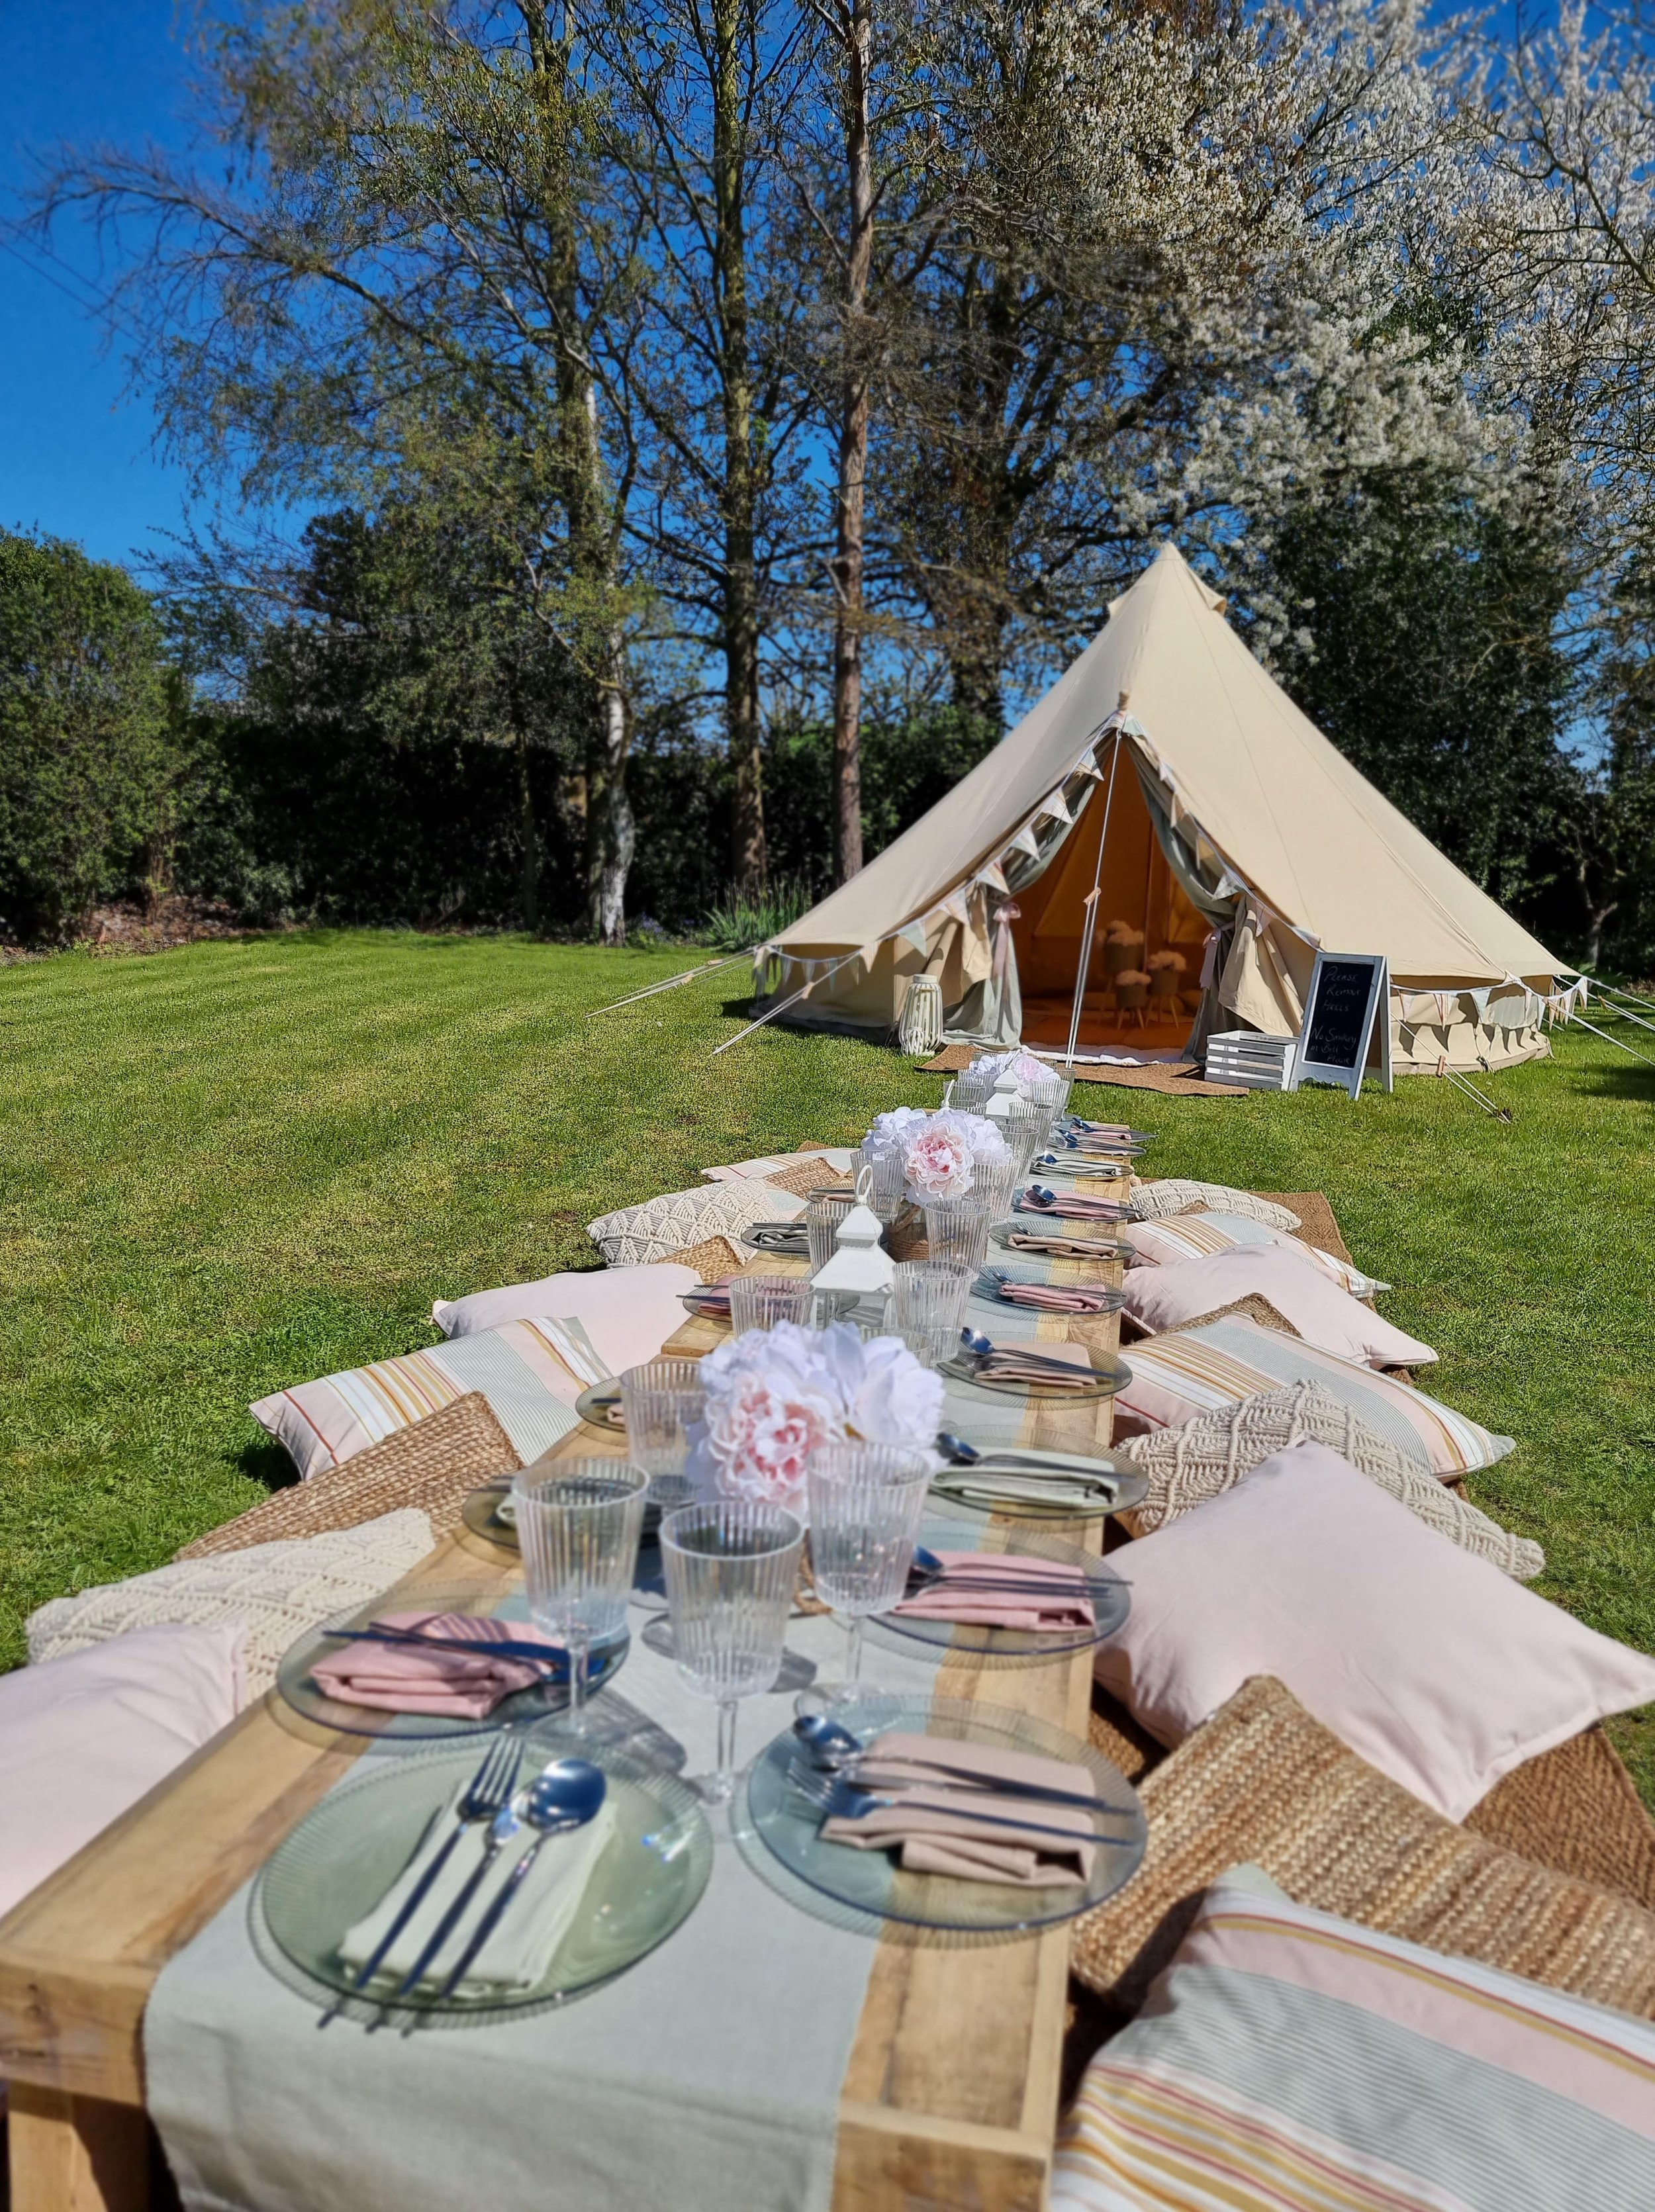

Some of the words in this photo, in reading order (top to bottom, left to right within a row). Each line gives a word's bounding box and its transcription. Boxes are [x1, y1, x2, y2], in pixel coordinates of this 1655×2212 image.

[1324, 966, 1358, 982] PLEASE
[1322, 999, 1349, 1011] HEELS
[1311, 1025, 1324, 1040] No
